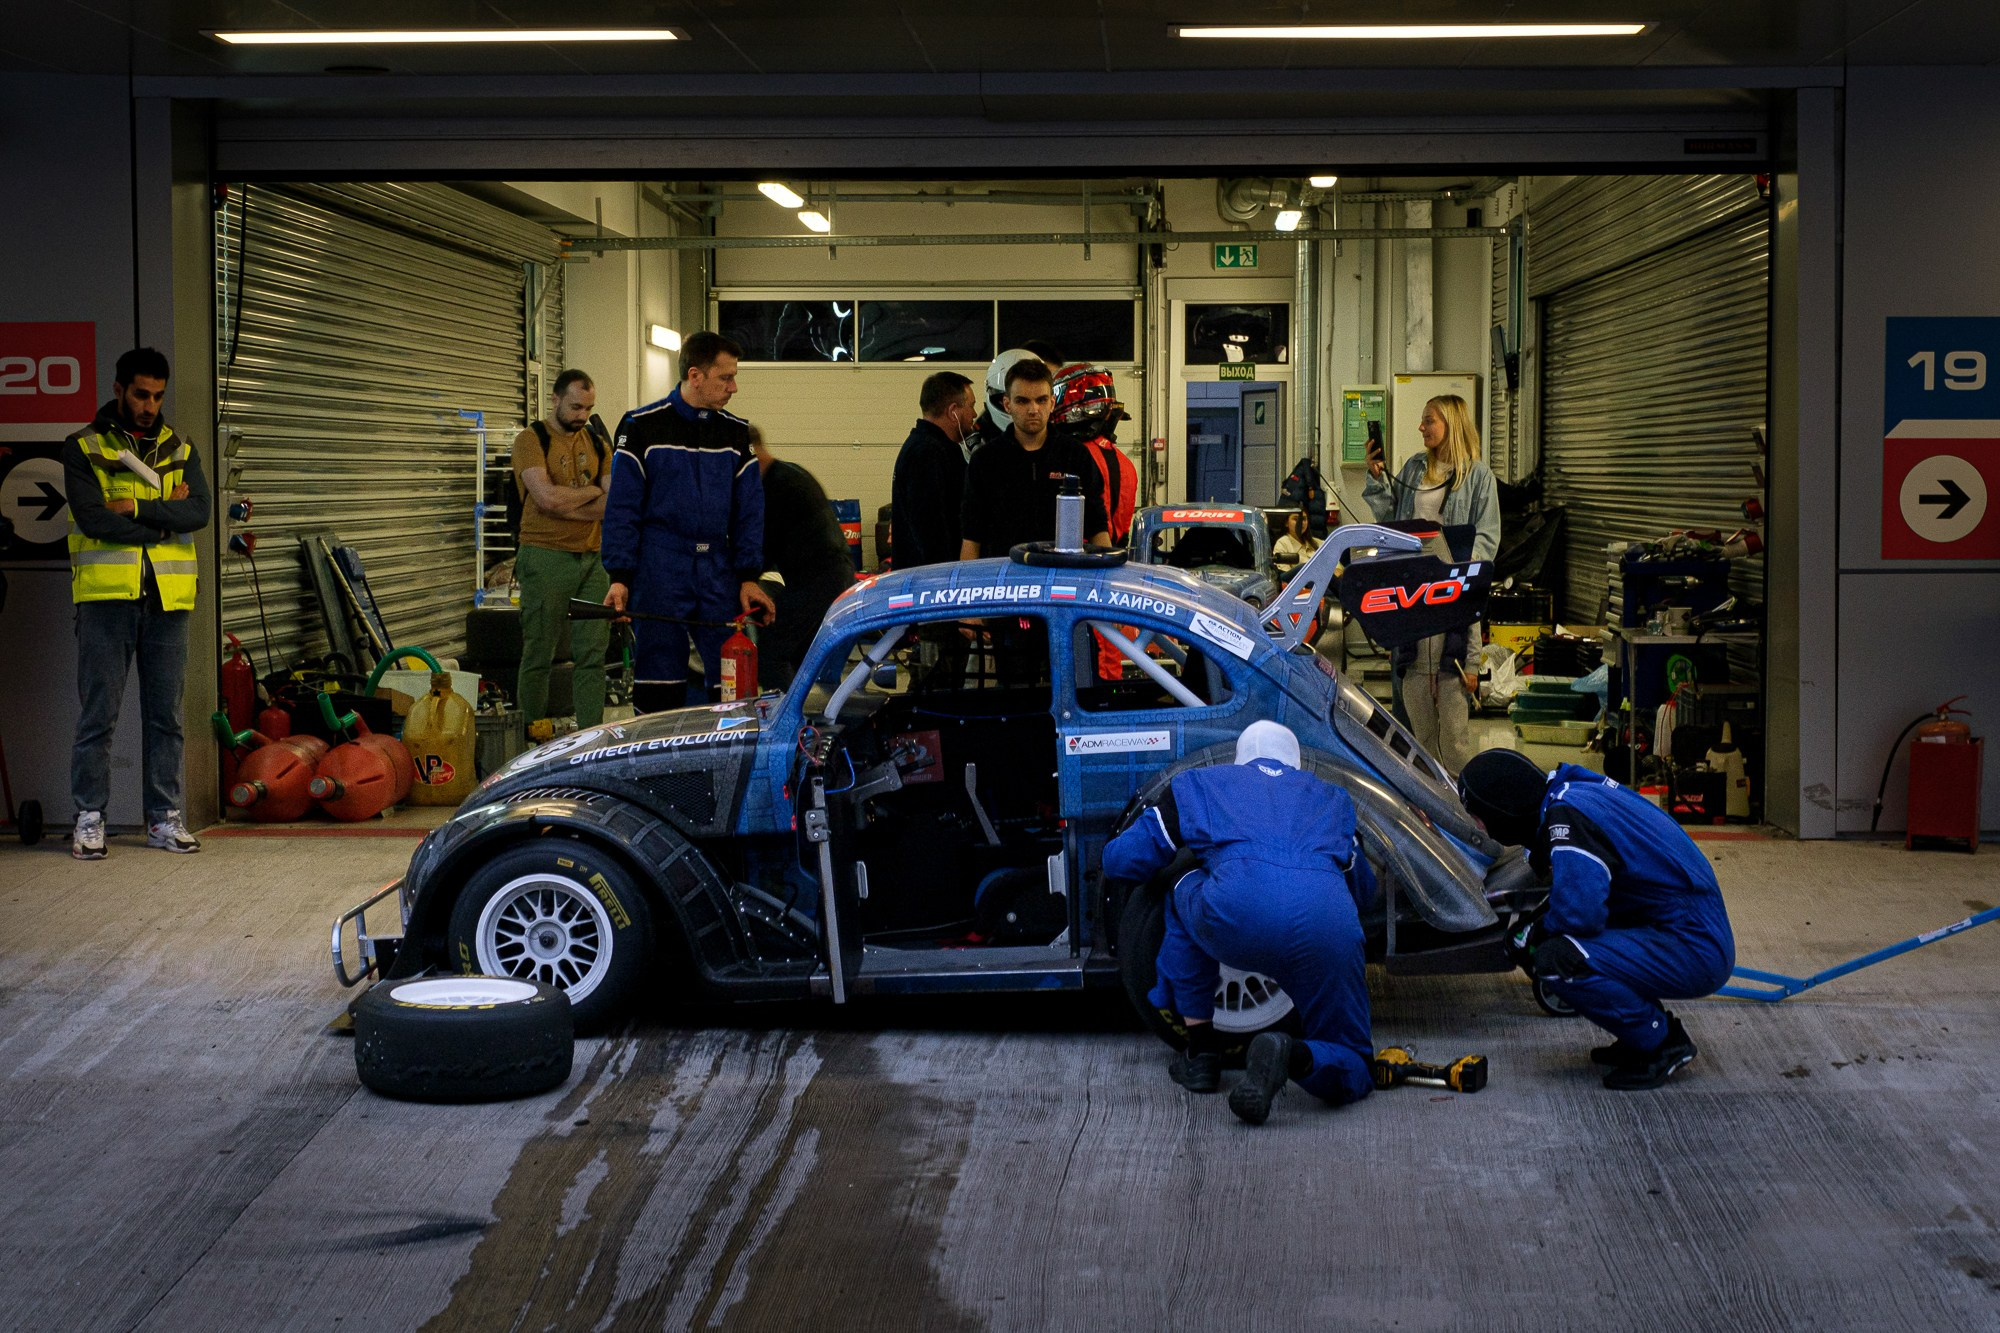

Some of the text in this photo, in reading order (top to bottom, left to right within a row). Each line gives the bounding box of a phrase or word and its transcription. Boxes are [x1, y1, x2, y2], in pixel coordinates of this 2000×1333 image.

[0, 356, 80, 395] 20
[1221, 366, 1254, 379] ВЫХОД
[1907, 351, 1987, 391] 19
[1108, 591, 1176, 616] ХАИРОВ
[1360, 580, 1462, 614] EVO
[1218, 626, 1242, 641] ACTION
[648, 730, 748, 750] EVOLUTION
[413, 754, 443, 785] VP
[1549, 826, 1570, 839] OMP
[588, 872, 631, 930] PIRELLI
